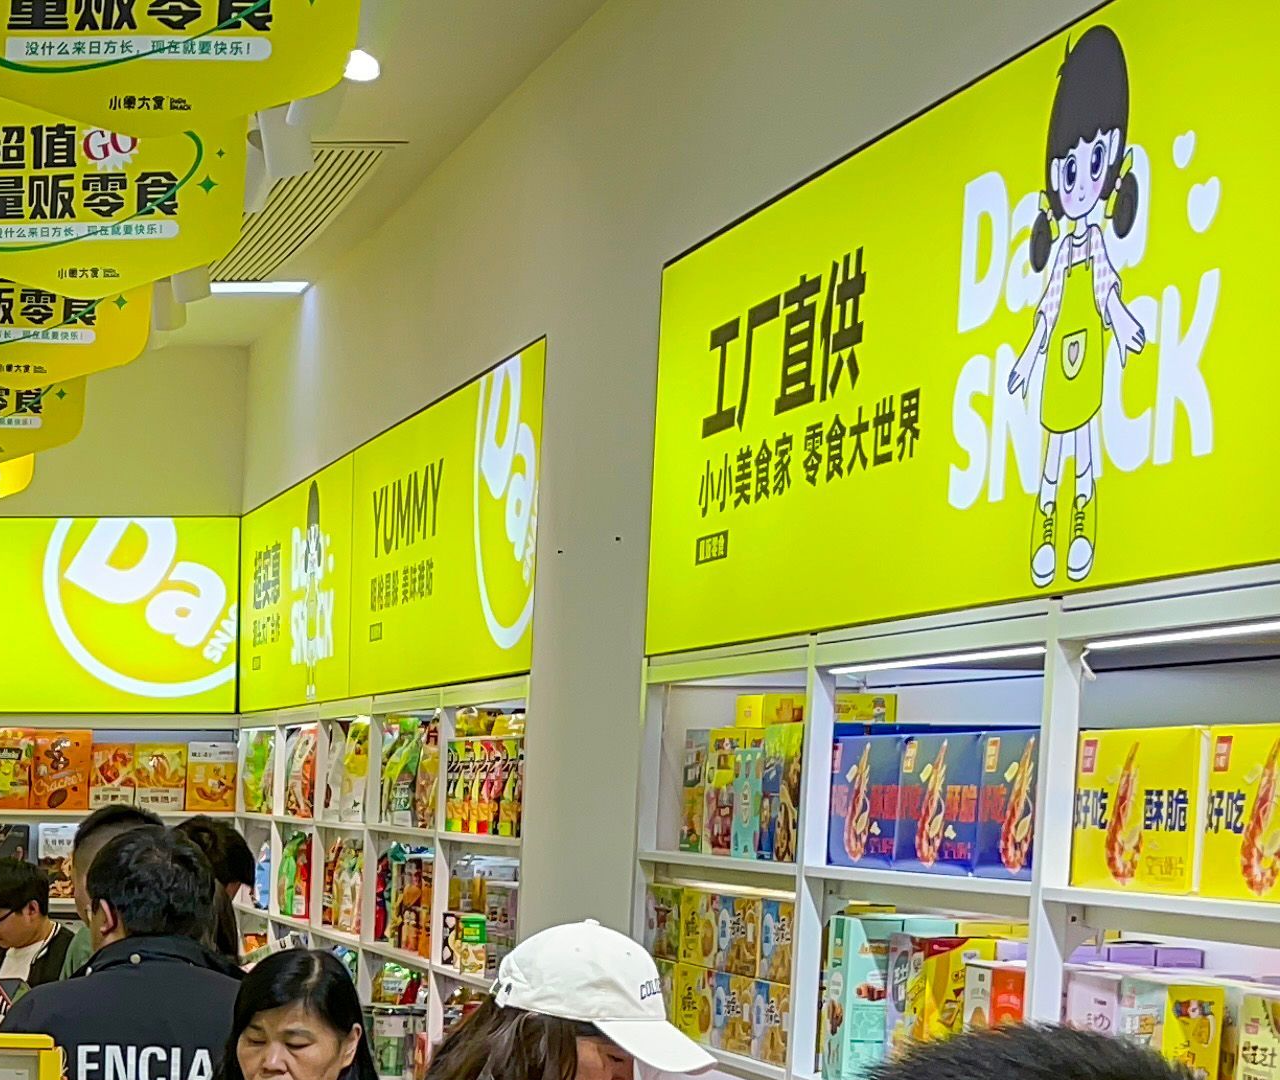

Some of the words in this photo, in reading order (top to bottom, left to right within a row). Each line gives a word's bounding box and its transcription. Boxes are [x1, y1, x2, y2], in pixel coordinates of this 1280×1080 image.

[83, 130, 139, 161] GO
[701, 246, 867, 440] 工厂直供
[948, 268, 1222, 510] SNCK
[372, 457, 445, 559] YUMMY
[698, 433, 793, 518] 小小美食家
[804, 388, 922, 488] 零食大世界
[63, 517, 227, 648] Da
[1143, 788, 1189, 832] 酥脆
